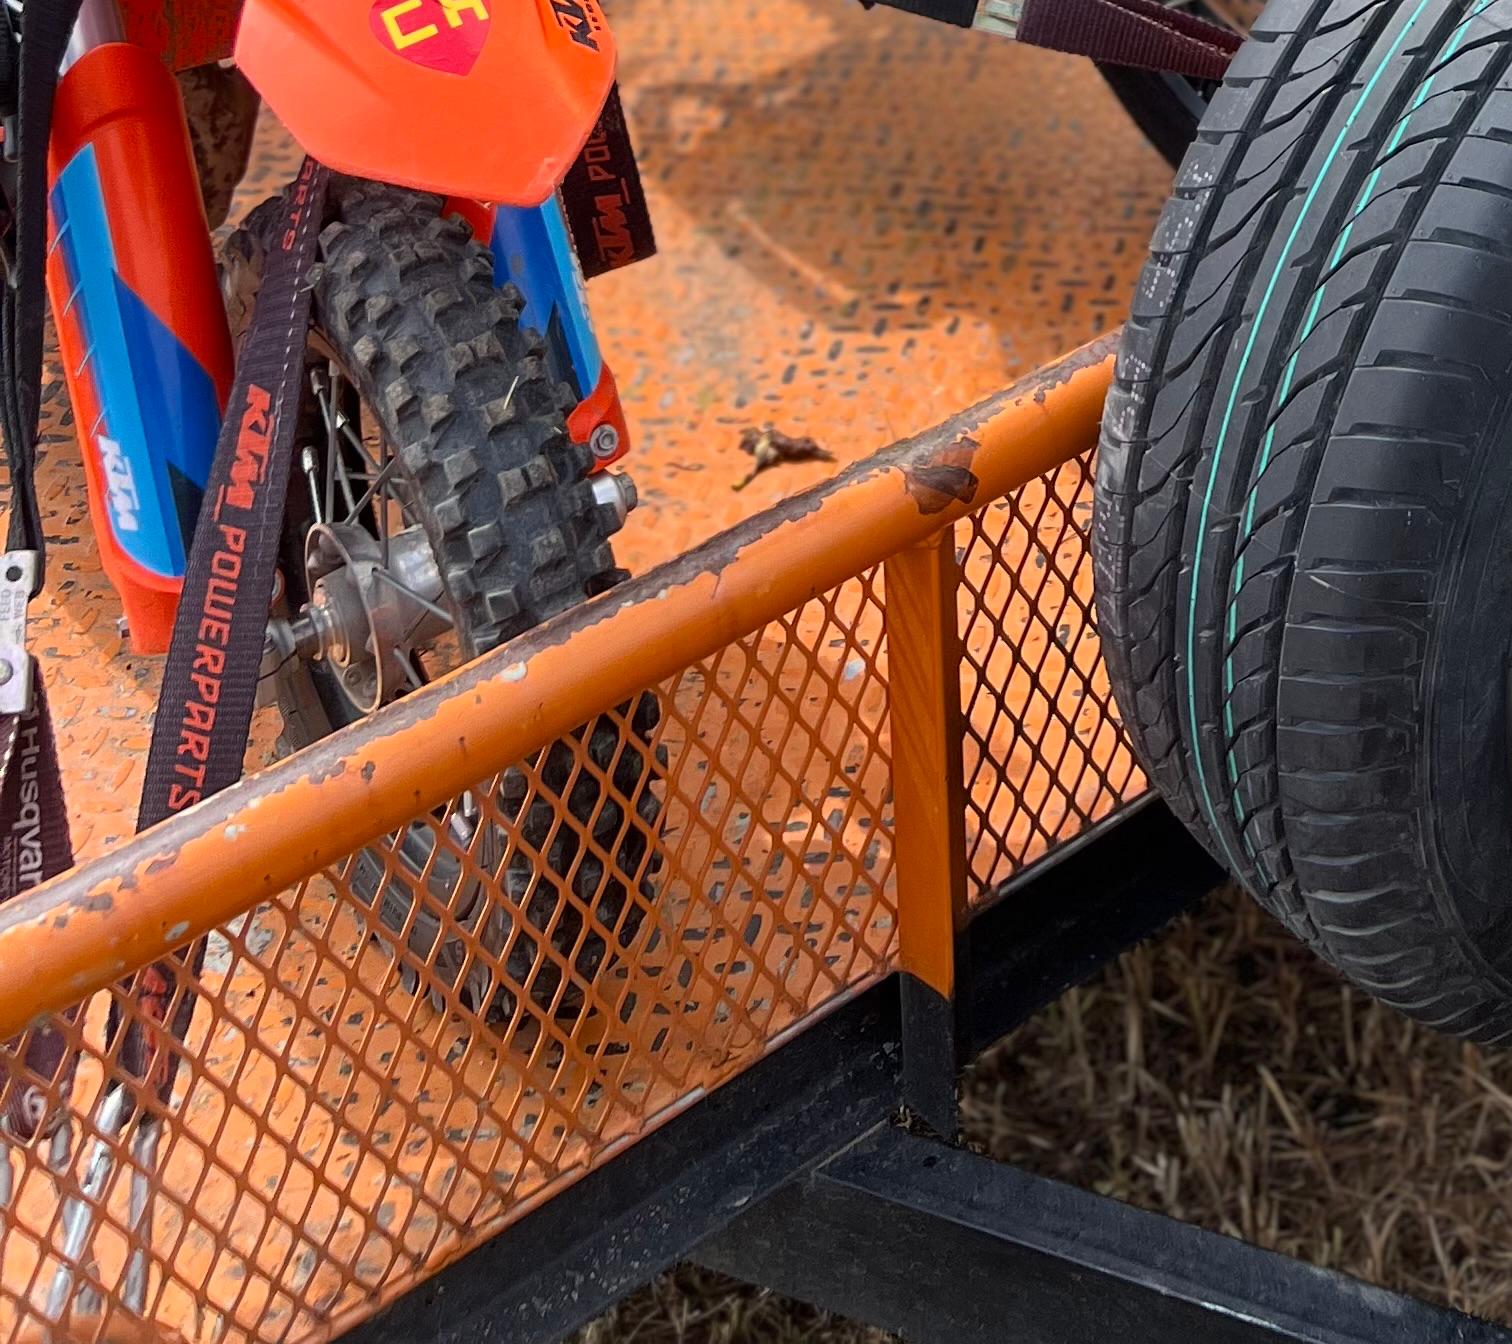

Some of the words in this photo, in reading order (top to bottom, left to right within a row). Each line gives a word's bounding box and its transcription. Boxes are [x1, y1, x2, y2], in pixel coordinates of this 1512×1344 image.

[97, 434, 141, 532] KTM
[222, 384, 271, 512] KTM
[168, 524, 248, 810] POWERPARTS
[11, 725, 44, 886] Husqvar
